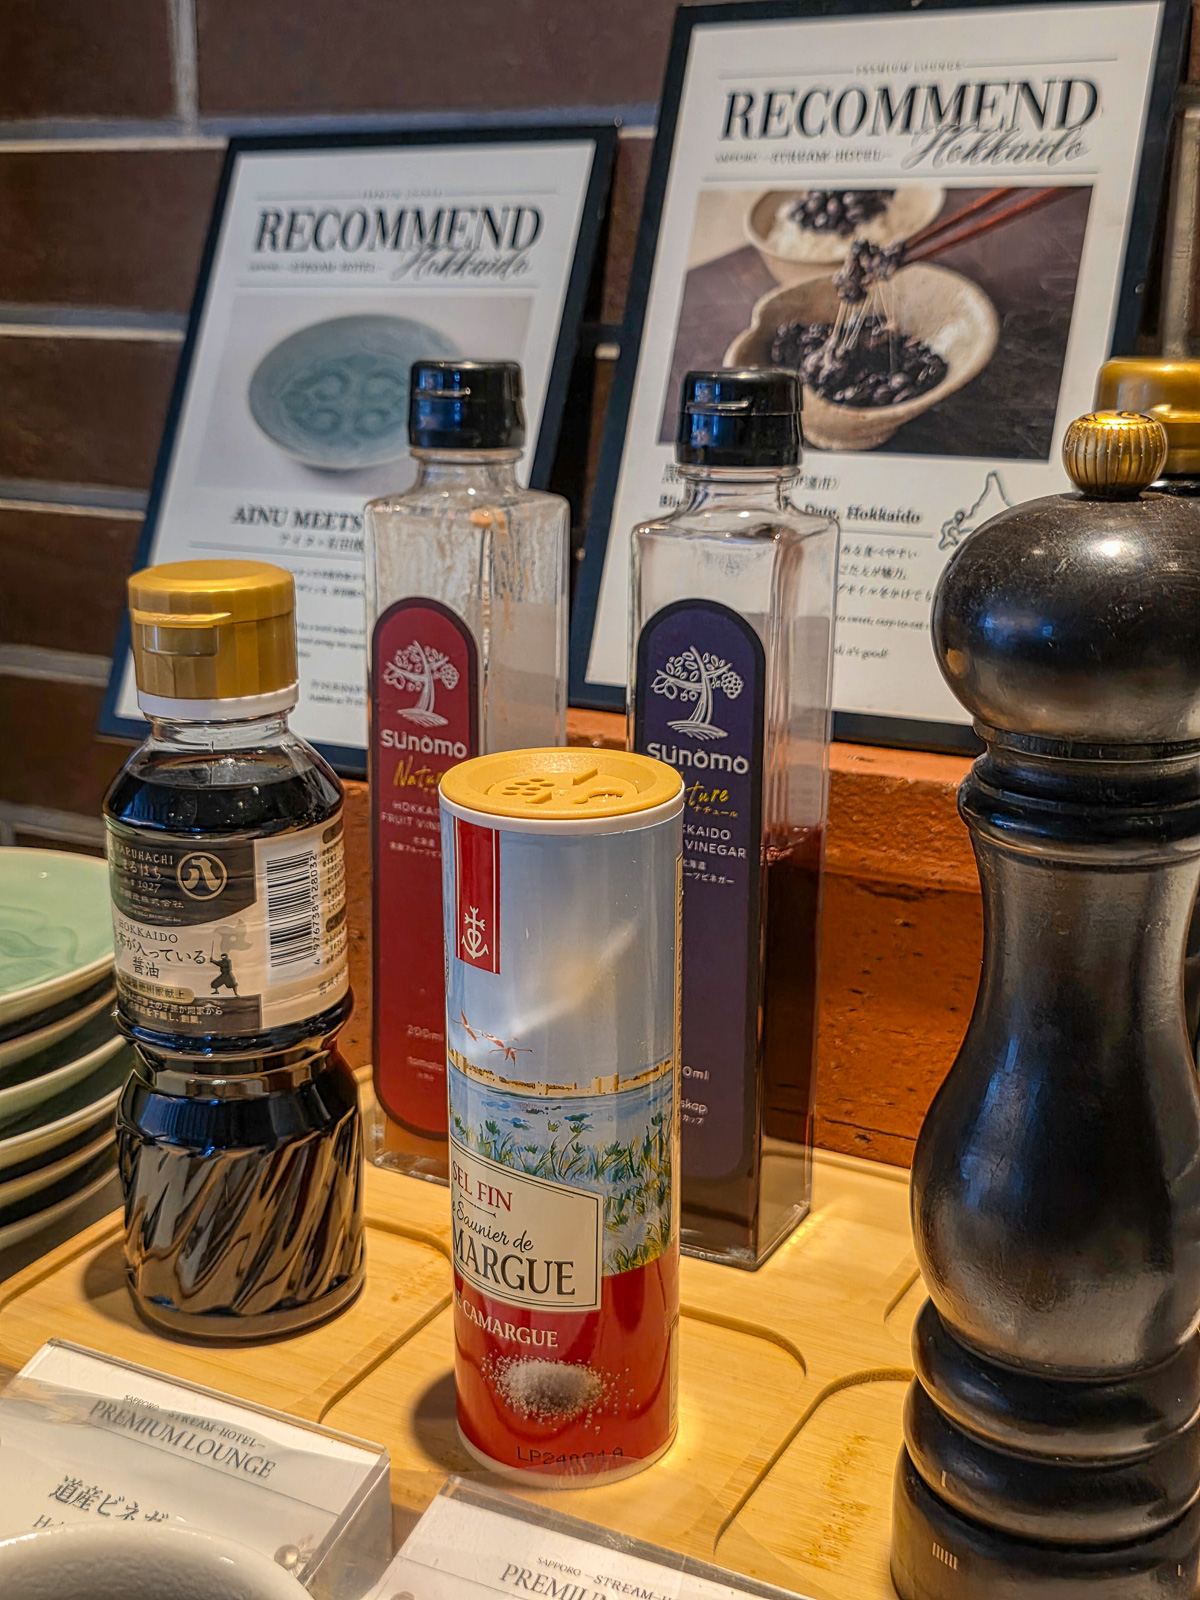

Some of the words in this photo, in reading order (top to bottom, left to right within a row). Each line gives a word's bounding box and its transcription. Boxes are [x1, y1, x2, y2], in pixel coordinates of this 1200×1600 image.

[720, 76, 1100, 142] RECOMMEND
[254, 203, 544, 254] RECOMMEND
[846, 505, 923, 526] Hokkaido
[416, 819, 442, 833] VINE
[684, 839, 748, 859] VINEGAR
[138, 880, 161, 894] 1927
[452, 1160, 473, 1196] SEL
[476, 1180, 513, 1212] FIN
[456, 1200, 510, 1246] Saunier
[512, 1229, 534, 1253] de
[452, 1216, 576, 1296] MARGUE
[463, 1299, 558, 1347] CAMARGUE
[89, 1399, 187, 1446] PREMIUM
[183, 1433, 277, 1479] LOUNGE
[537, 1556, 582, 1577] SAPPORO
[594, 1574, 653, 1600] STREAM
